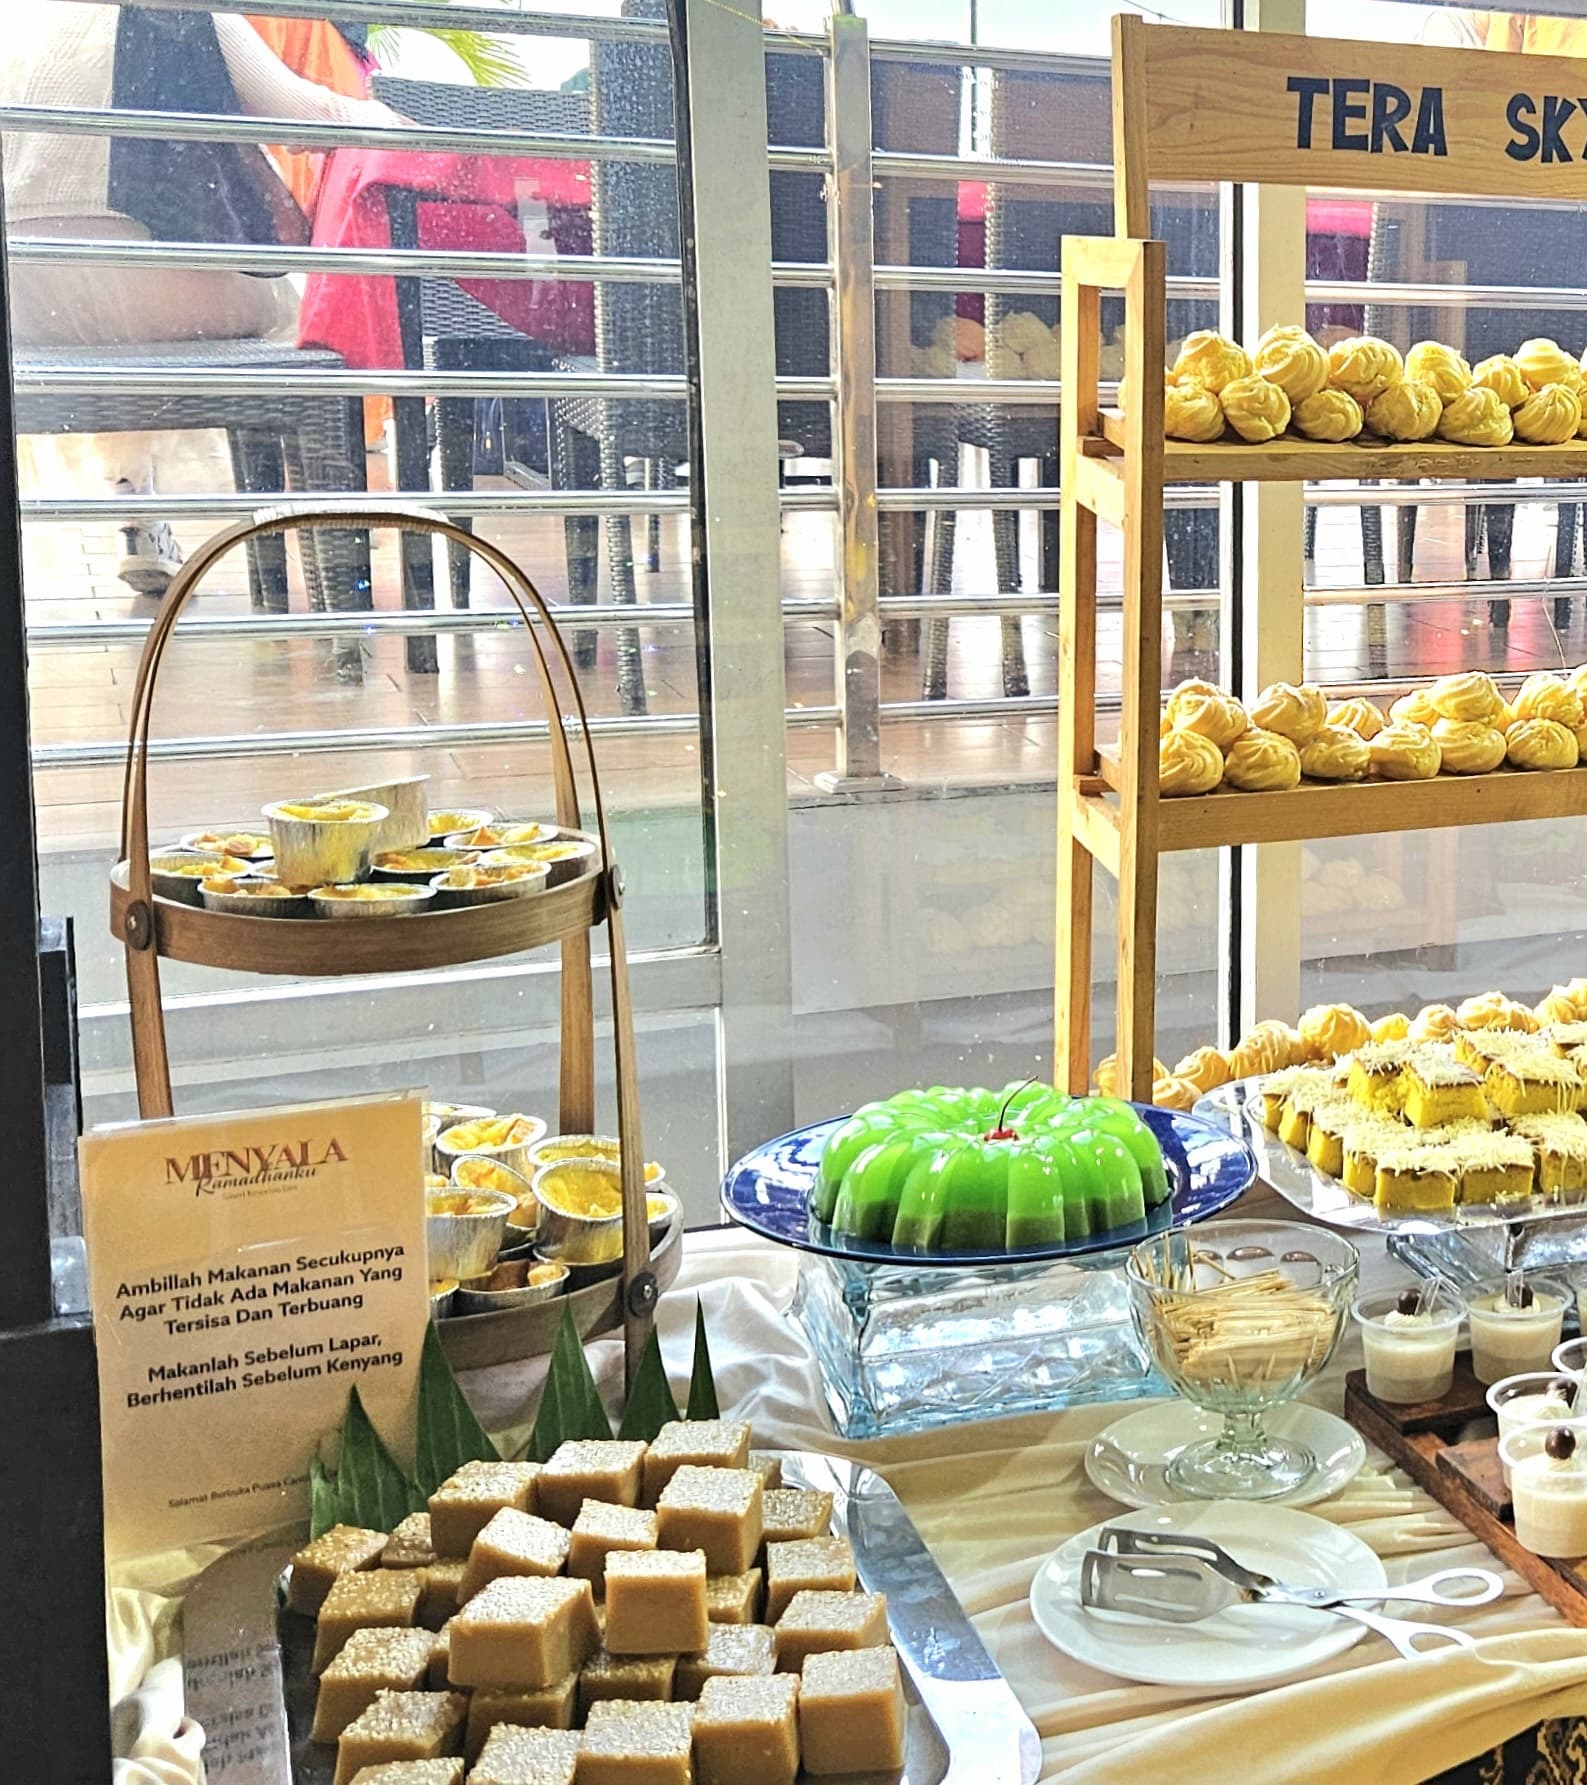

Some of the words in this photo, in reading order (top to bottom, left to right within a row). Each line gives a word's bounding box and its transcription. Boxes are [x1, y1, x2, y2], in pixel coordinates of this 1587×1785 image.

[1286, 76, 1448, 157] TERA
[164, 1136, 349, 1185] MENYALA
[195, 1162, 317, 1197] Ramadhanku
[116, 1272, 202, 1298] Ambillah
[207, 1260, 291, 1284] Makanan
[296, 1245, 405, 1271] Secukupnya
[120, 1303, 166, 1321] Agar
[171, 1291, 225, 1312] Tidak
[230, 1286, 267, 1303] Ada
[273, 1274, 354, 1296] Makanan
[360, 1265, 402, 1283] Yang
[164, 1314, 231, 1335] Tersisa
[236, 1308, 273, 1324] Dan
[278, 1293, 364, 1317] Terbuang
[126, 1374, 237, 1408] Berhentilah
[242, 1362, 322, 1388] Sebelum
[327, 1351, 404, 1374] Kenyang
[148, 1355, 239, 1382] Makanlah
[244, 1342, 324, 1366] Sebelum
[329, 1333, 383, 1352] Lapar,
